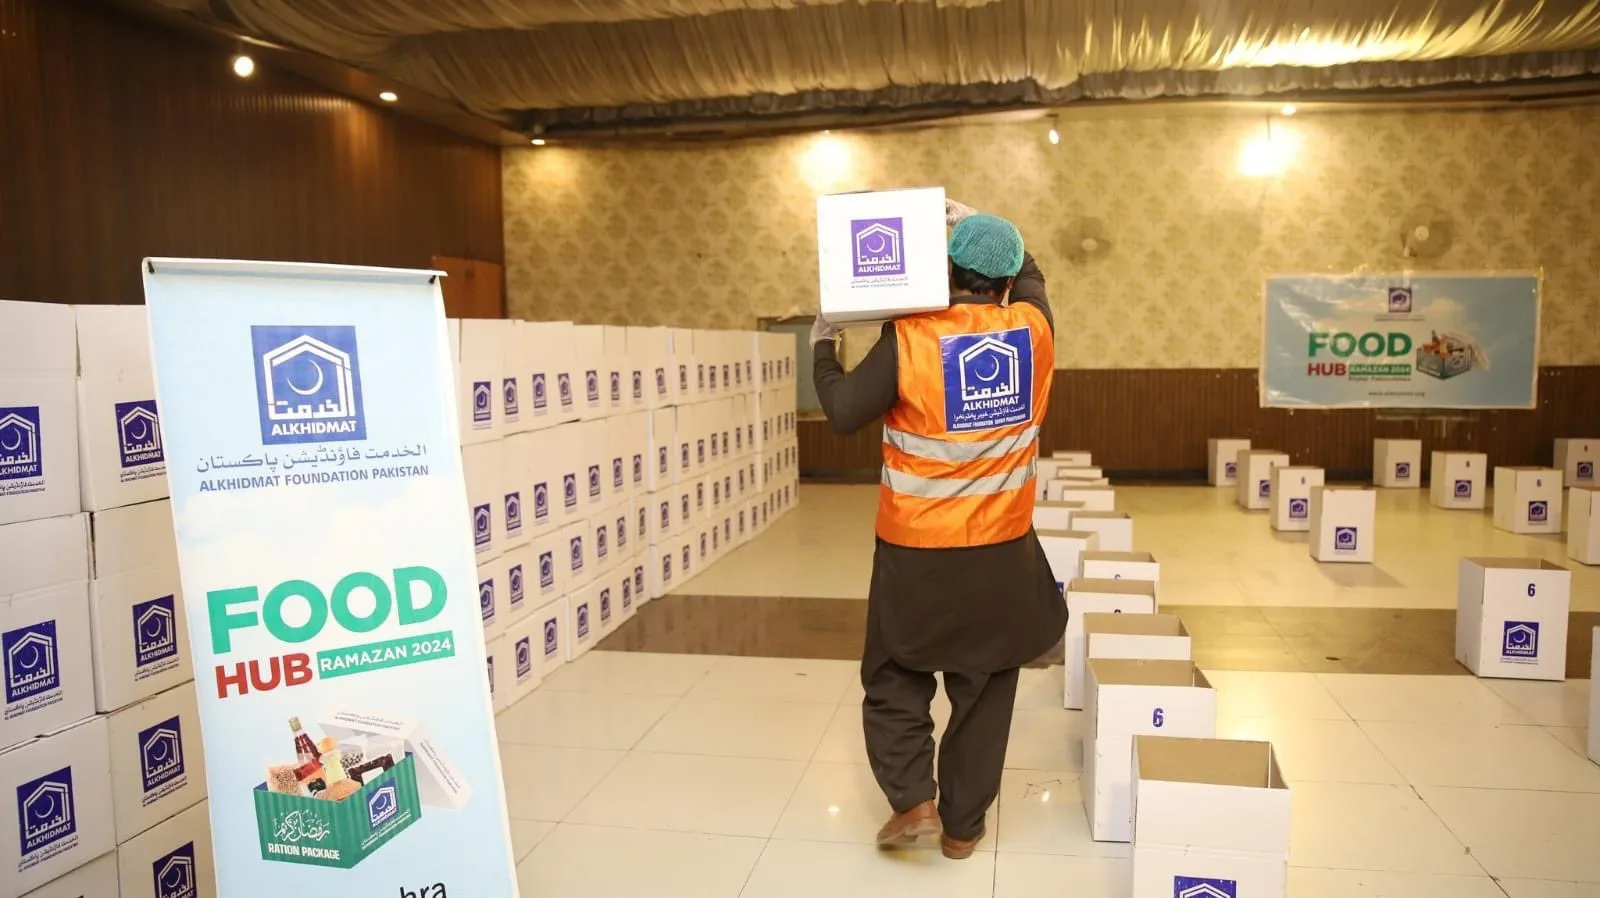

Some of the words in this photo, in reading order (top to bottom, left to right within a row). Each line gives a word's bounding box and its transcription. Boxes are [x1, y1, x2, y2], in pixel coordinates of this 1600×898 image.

[1308, 332, 1412, 357] FOOD
[1307, 363, 1347, 376] HUB
[963, 395, 1020, 411] ALKHIDMAT
[271, 420, 357, 436] ALKHIDMAT
[125, 450, 161, 463] ALKHIDMAT
[365, 443, 427, 459] الخدمت
[197, 452, 278, 473] پاکستان
[199, 475, 281, 492] ALKHIDMAT
[285, 470, 369, 486] FOUNDATION
[372, 465, 429, 479] PAKISTAN
[1527, 583, 1536, 597] 6
[206, 566, 448, 655] FOOD
[140, 644, 174, 661] ALKHIDMAT
[215, 653, 313, 699] HUB
[319, 647, 408, 673] RAMAZAN
[412, 637, 452, 657] 2024
[11, 676, 56, 697] ALKHIDMAT
[1152, 708, 1164, 727] 6
[146, 765, 181, 787] ALKHIDMAT
[26, 822, 72, 849] ALKHIDMAT
[267, 842, 300, 856] RATION
[301, 846, 341, 860] PACKAGE
